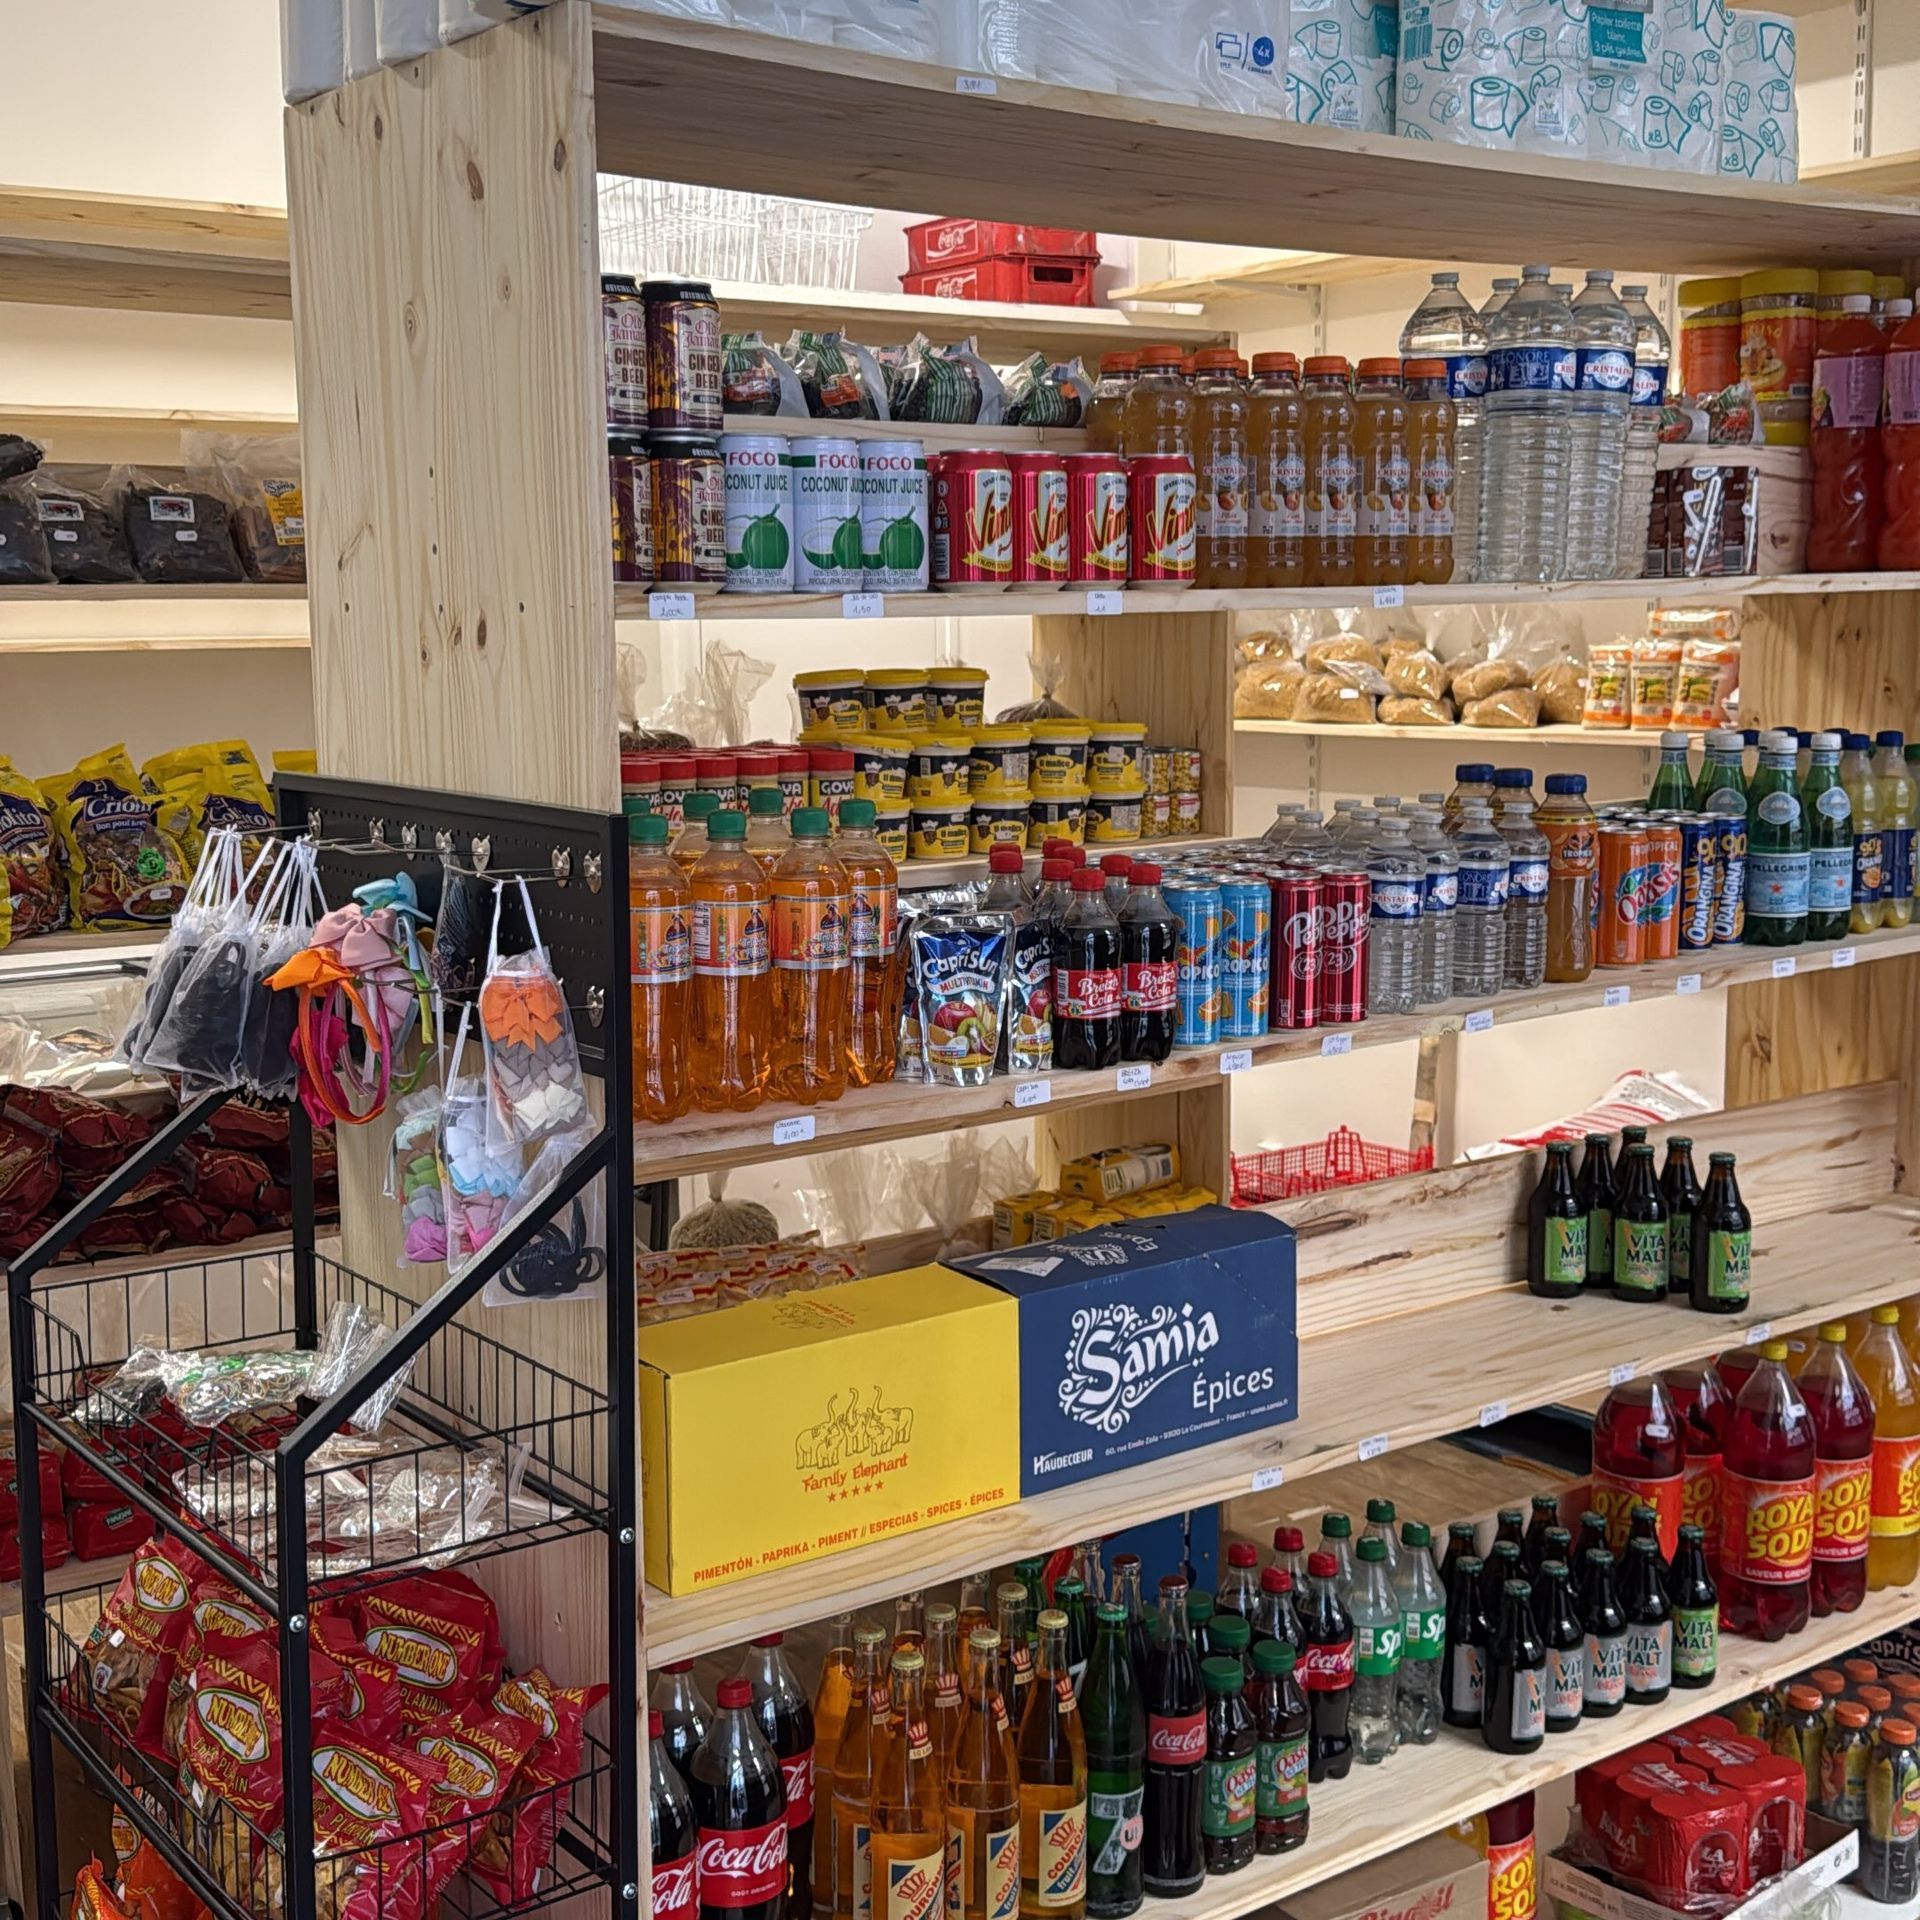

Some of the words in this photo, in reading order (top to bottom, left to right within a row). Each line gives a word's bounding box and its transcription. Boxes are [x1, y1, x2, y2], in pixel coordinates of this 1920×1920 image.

[1648, 130, 1662, 143] x8
[1724, 154, 1739, 167] x8
[729, 452, 776, 466] FOCO
[819, 454, 860, 469] FOCO
[867, 457, 911, 471] FOCO
[764, 474, 788, 491] JUICE
[802, 476, 848, 493] COCONUT
[901, 479, 923, 494] JUICE
[1337, 901, 1363, 922] Dr
[1327, 952, 1342, 967] 23
[1078, 974, 1119, 996] Breizh
[1149, 986, 1172, 1000] Cola
[1088, 993, 1114, 1007] Cola
[1079, 1303, 1221, 1406] Samia
[1193, 1367, 1274, 1413] Épices
[802, 1468, 848, 1493] Family
[852, 1452, 909, 1480] Elephant
[1746, 1493, 1814, 1536] ROYA
[693, 1556, 753, 1583] PIMENTÓN
[762, 1541, 810, 1565] PAPRIKA
[818, 1527, 858, 1549] PIMENT
[869, 1511, 919, 1535] ESPECIAS
[926, 1500, 962, 1518] SPICES
[970, 1487, 1005, 1507] ÉPICES
[377, 1632, 431, 1677] NUMBER
[428, 1650, 450, 1681] ONE
[1091, 1784, 1144, 1875] 7
